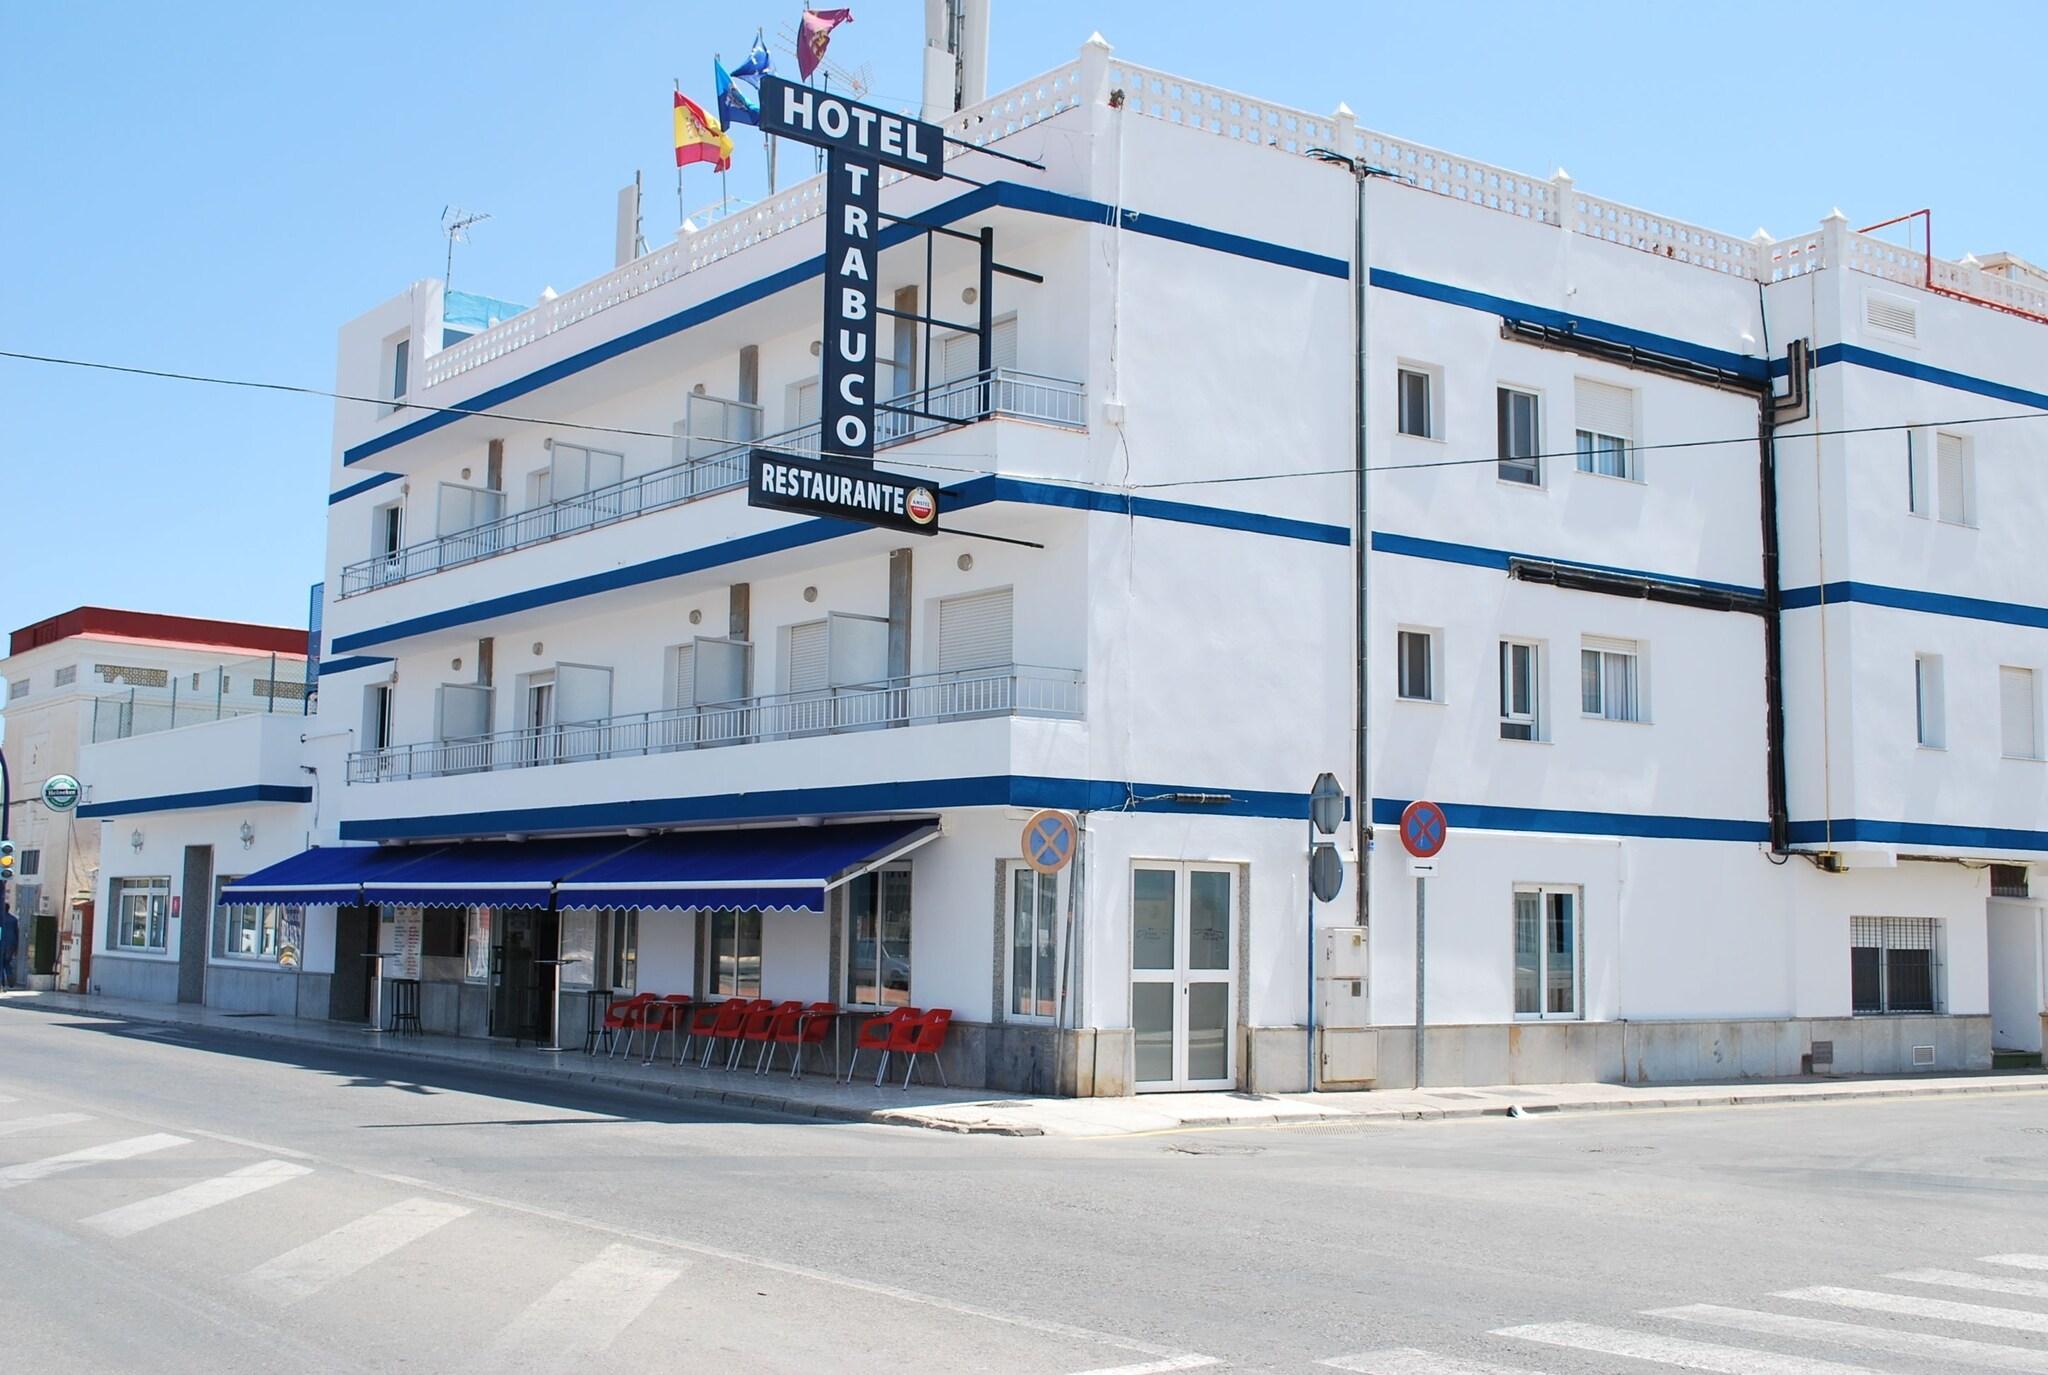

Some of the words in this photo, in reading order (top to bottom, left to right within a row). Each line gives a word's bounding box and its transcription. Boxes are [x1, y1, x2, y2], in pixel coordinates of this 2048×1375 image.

[783, 86, 928, 164] HOTEL
[836, 163, 869, 447] TRABUCO
[761, 463, 905, 515] RESTAURANTE
